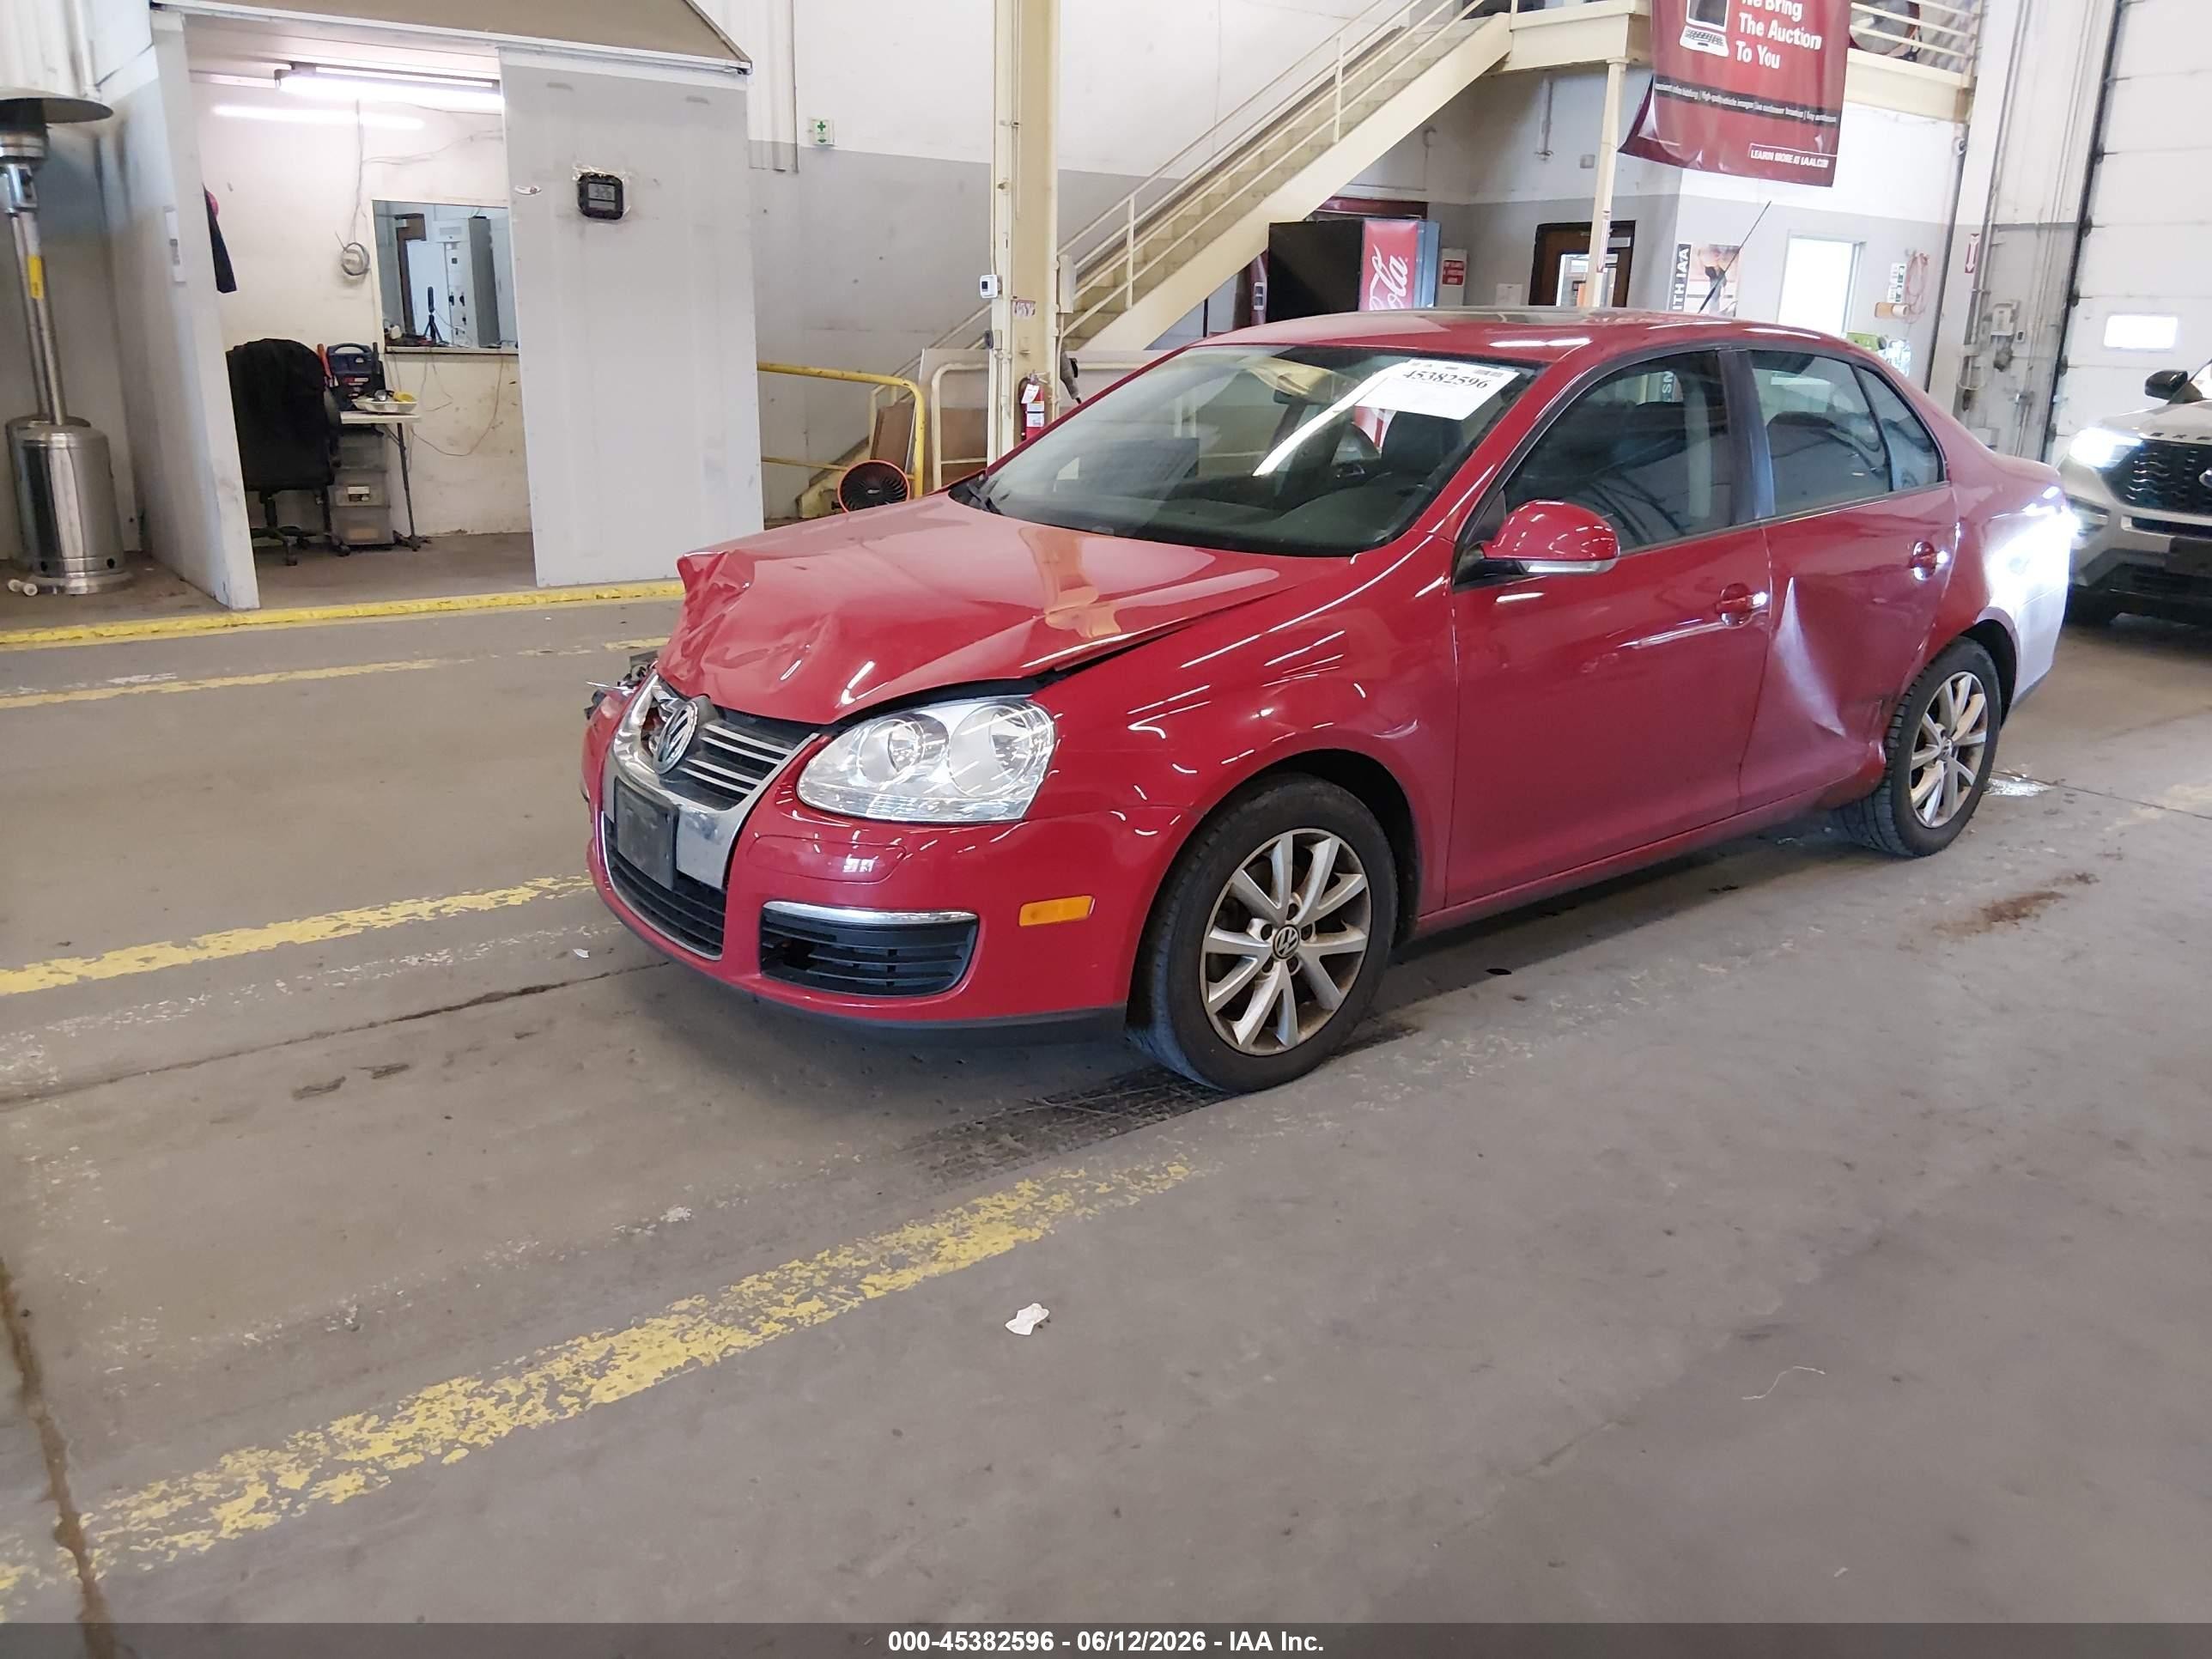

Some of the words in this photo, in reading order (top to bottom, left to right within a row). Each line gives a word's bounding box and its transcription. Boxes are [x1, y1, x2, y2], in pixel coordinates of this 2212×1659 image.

[1739, 12, 1765, 37] The
[1767, 19, 1822, 51] Auction
[1735, 40, 1753, 63] To
[1757, 44, 1781, 69] You
[1676, 248, 1690, 277] IAA
[1672, 283, 1685, 310] ITH
[1403, 370, 1492, 389] 45382596
